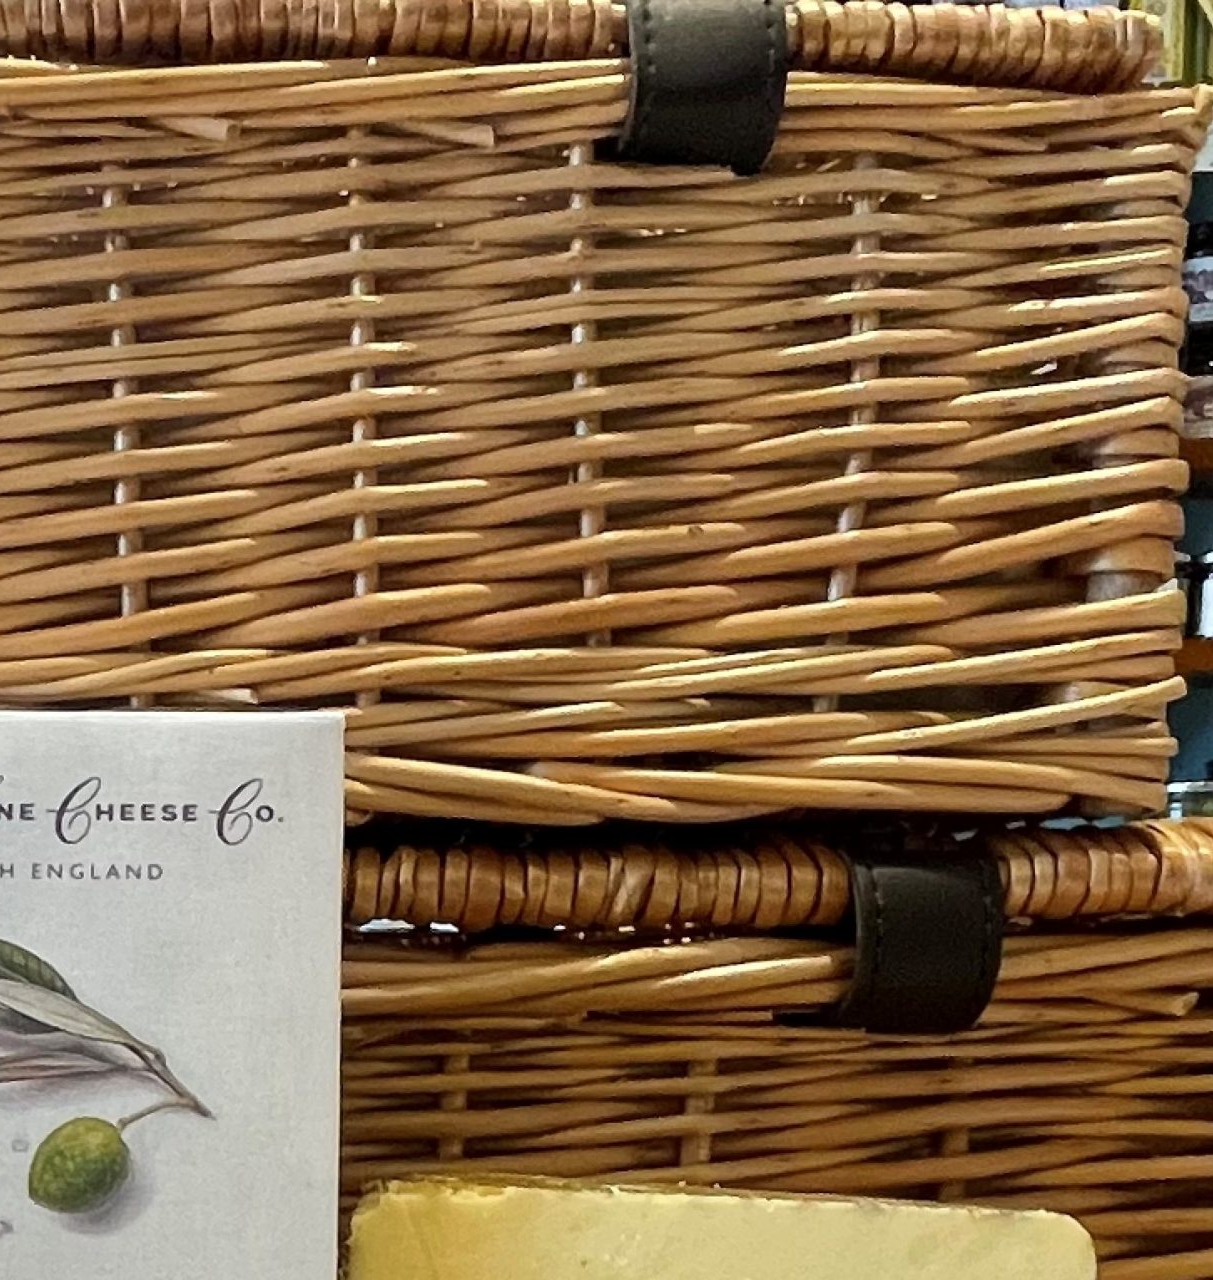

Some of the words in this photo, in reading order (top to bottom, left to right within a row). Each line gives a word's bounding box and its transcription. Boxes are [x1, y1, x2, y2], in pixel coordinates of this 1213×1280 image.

[47, 776, 198, 845] CHEESE
[209, 777, 284, 847] CO.
[31, 862, 164, 881] ENGLAND
